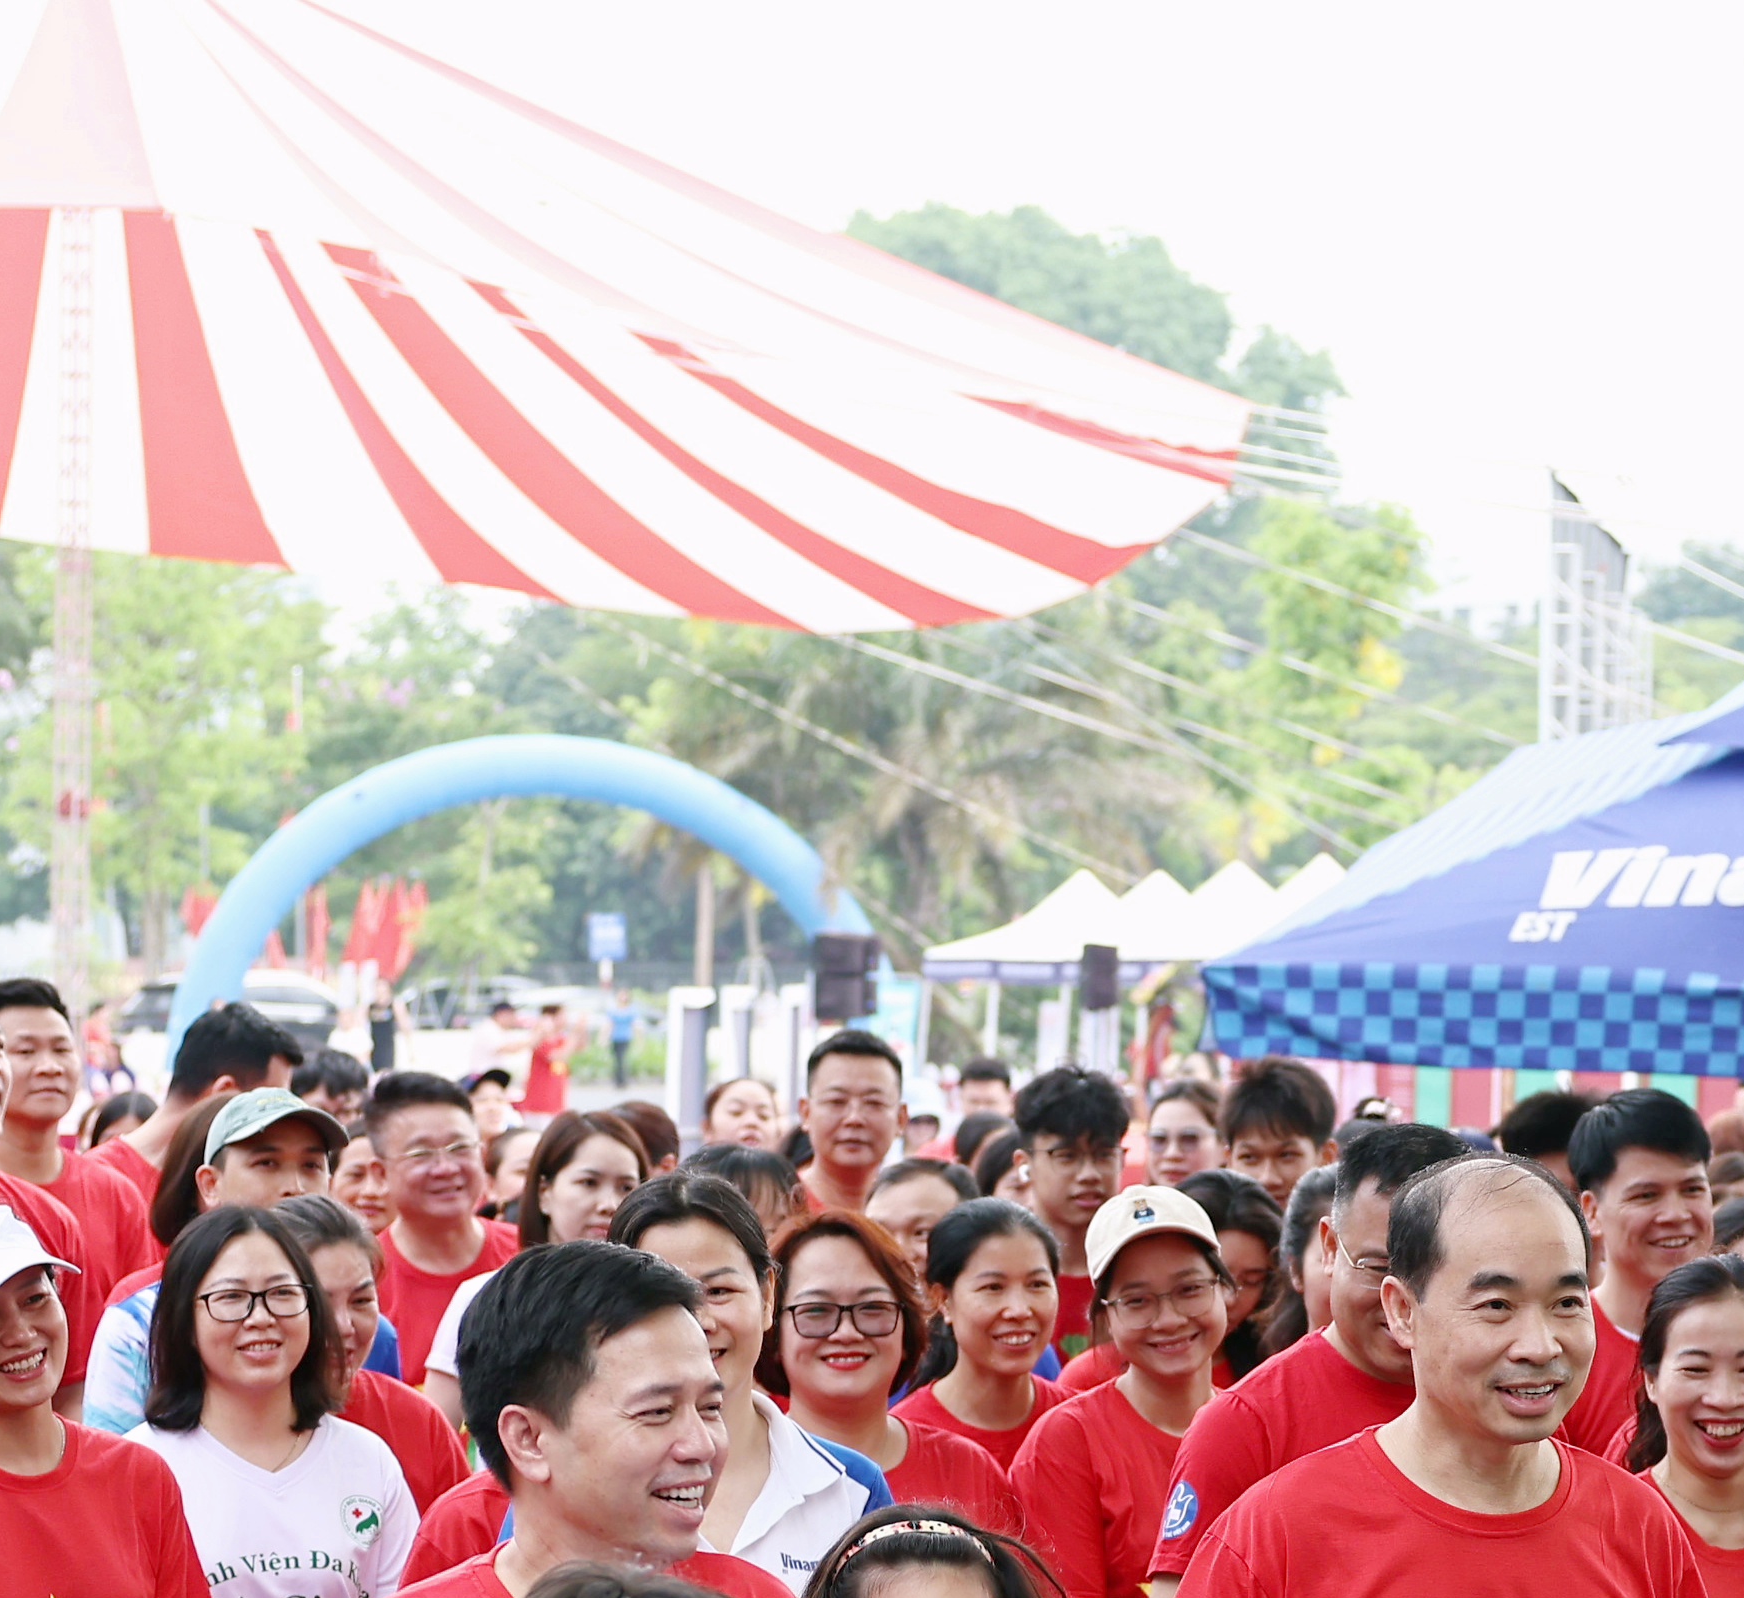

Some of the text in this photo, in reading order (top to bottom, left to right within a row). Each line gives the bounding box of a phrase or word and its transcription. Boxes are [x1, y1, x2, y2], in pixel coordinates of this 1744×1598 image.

[1507, 911, 1578, 942] EST
[205, 1561, 237, 1588] nh
[239, 1551, 300, 1576] Viện
[309, 1550, 343, 1574] Đa
